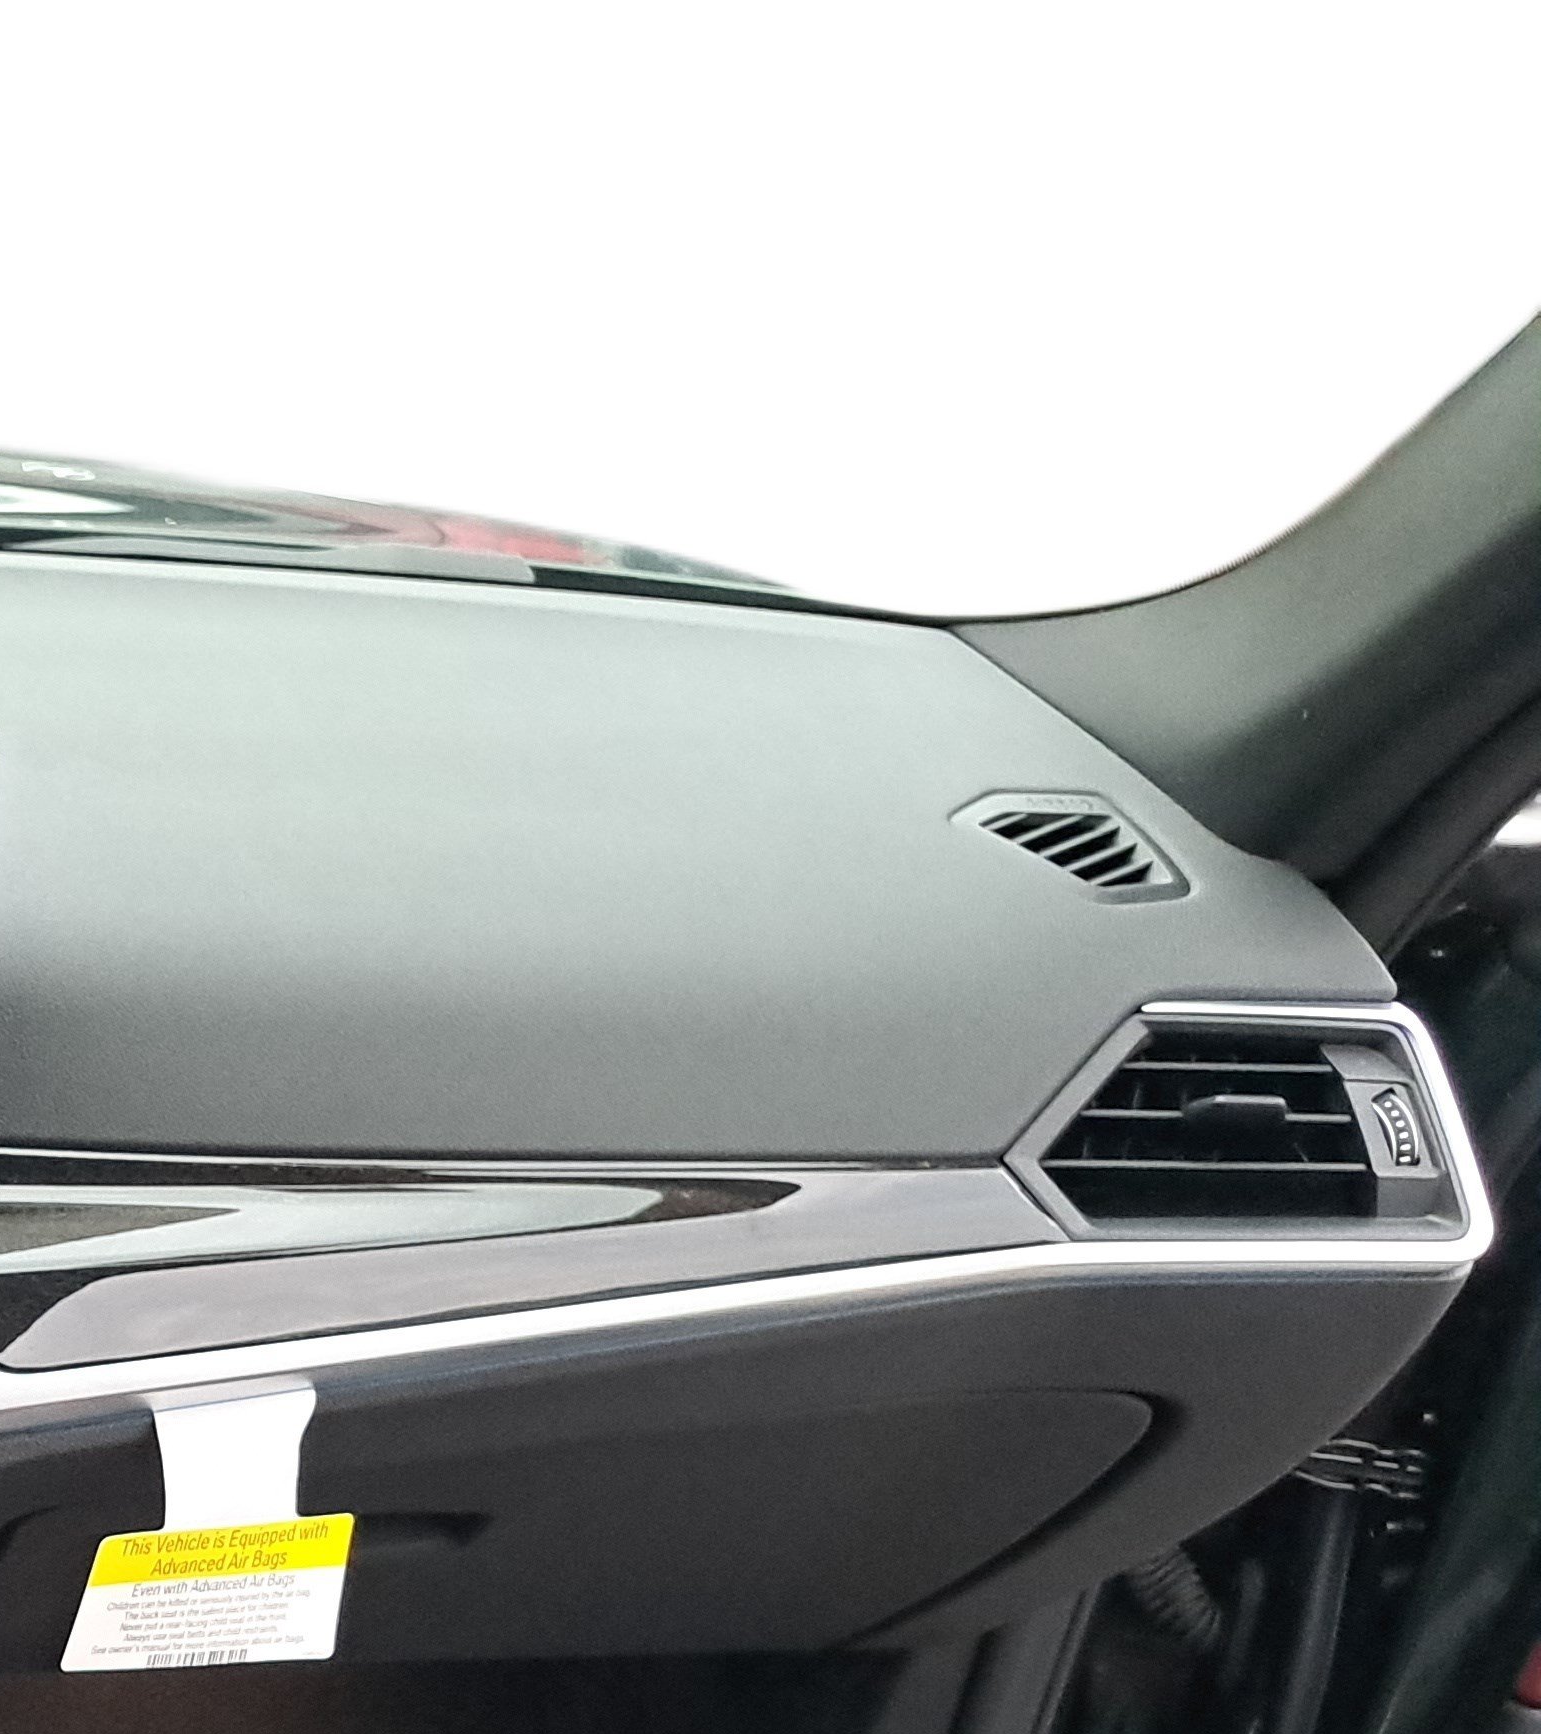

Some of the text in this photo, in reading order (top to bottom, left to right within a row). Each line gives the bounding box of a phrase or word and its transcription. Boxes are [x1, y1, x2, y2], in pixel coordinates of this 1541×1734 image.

[123, 1522, 328, 1557] This Vehicle is Equipped with
[150, 1550, 287, 1576] Advanced Air Bags
[132, 1584, 160, 1598] Even
[163, 1581, 188, 1594] with
[190, 1576, 247, 1592] Advanced
[268, 1573, 295, 1587] Bags
